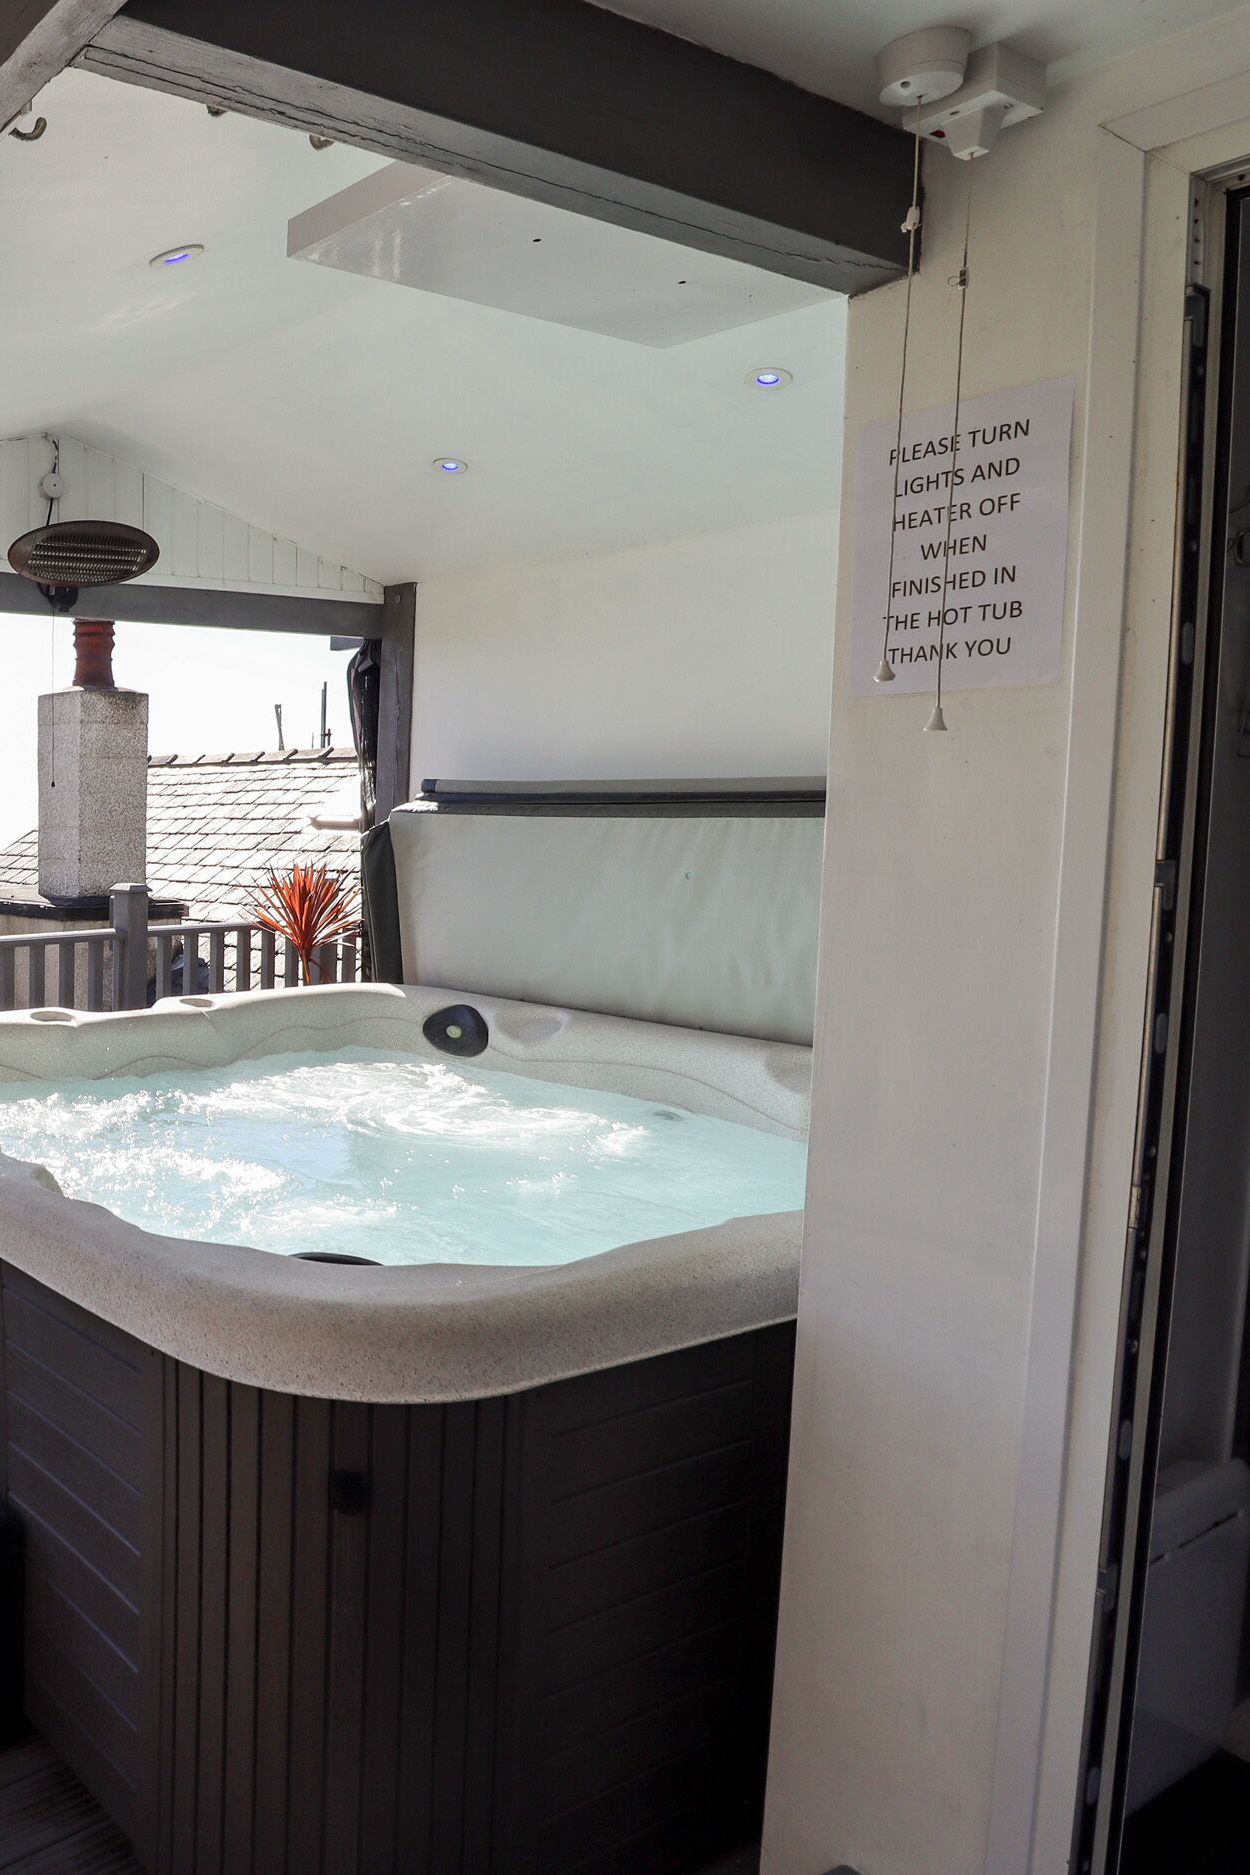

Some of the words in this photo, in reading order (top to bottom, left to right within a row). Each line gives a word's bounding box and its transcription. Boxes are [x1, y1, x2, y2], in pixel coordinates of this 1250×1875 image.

[889, 434, 962, 466] PLEASE
[968, 419, 1030, 448] TURN
[895, 468, 964, 498] LIGHTS
[971, 457, 1020, 483] AND
[893, 502, 972, 532] HEATER
[979, 493, 1021, 516] OFF
[920, 534, 987, 560] WHEN
[892, 570, 986, 598] FINISHED
[994, 565, 1016, 585] IN
[882, 612, 920, 632] THE
[928, 606, 972, 627] HOT
[978, 601, 1023, 622] TUB
[888, 642, 958, 665] THANK
[965, 637, 1011, 658] YOU
